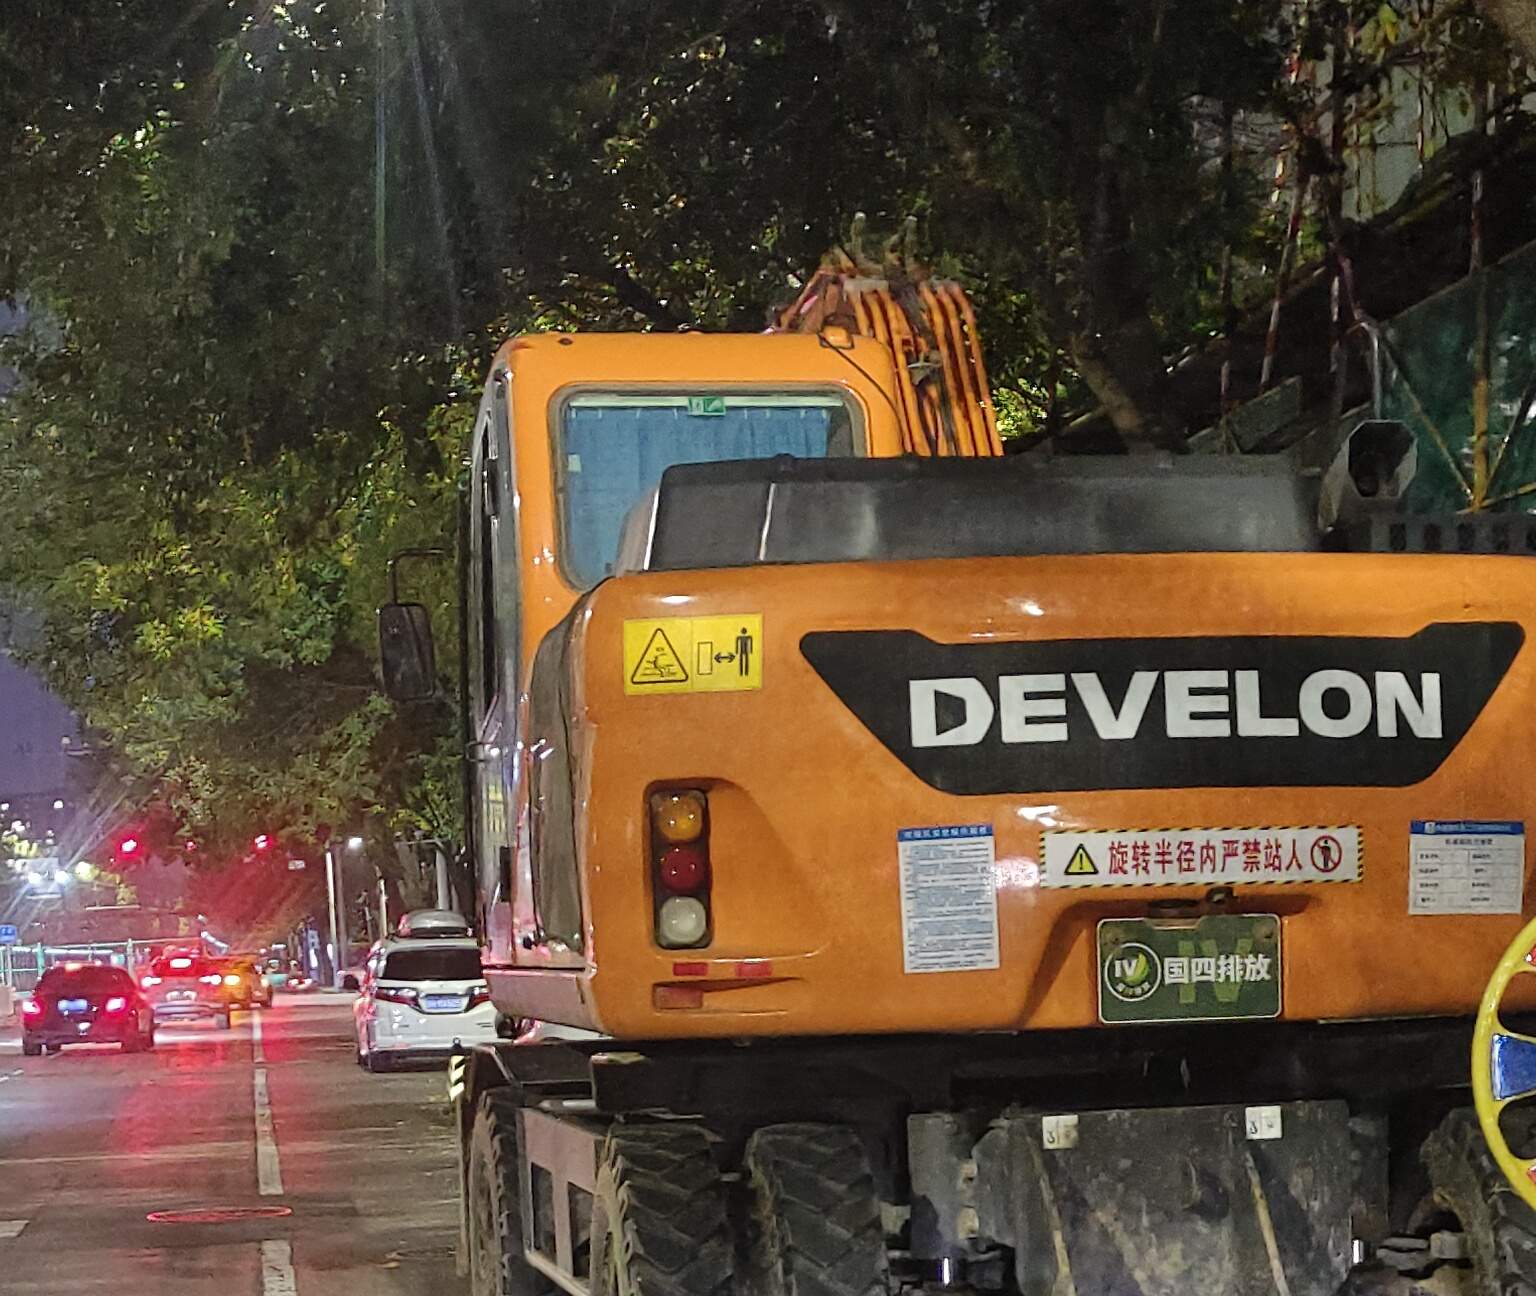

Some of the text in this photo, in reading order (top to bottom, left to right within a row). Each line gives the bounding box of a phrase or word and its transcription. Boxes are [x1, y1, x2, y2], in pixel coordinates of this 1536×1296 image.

[909, 669, 1442, 748] DEVELON
[1108, 838, 1304, 875] 旋转半径内严禁站人
[1164, 954, 1271, 984] 国四排放
